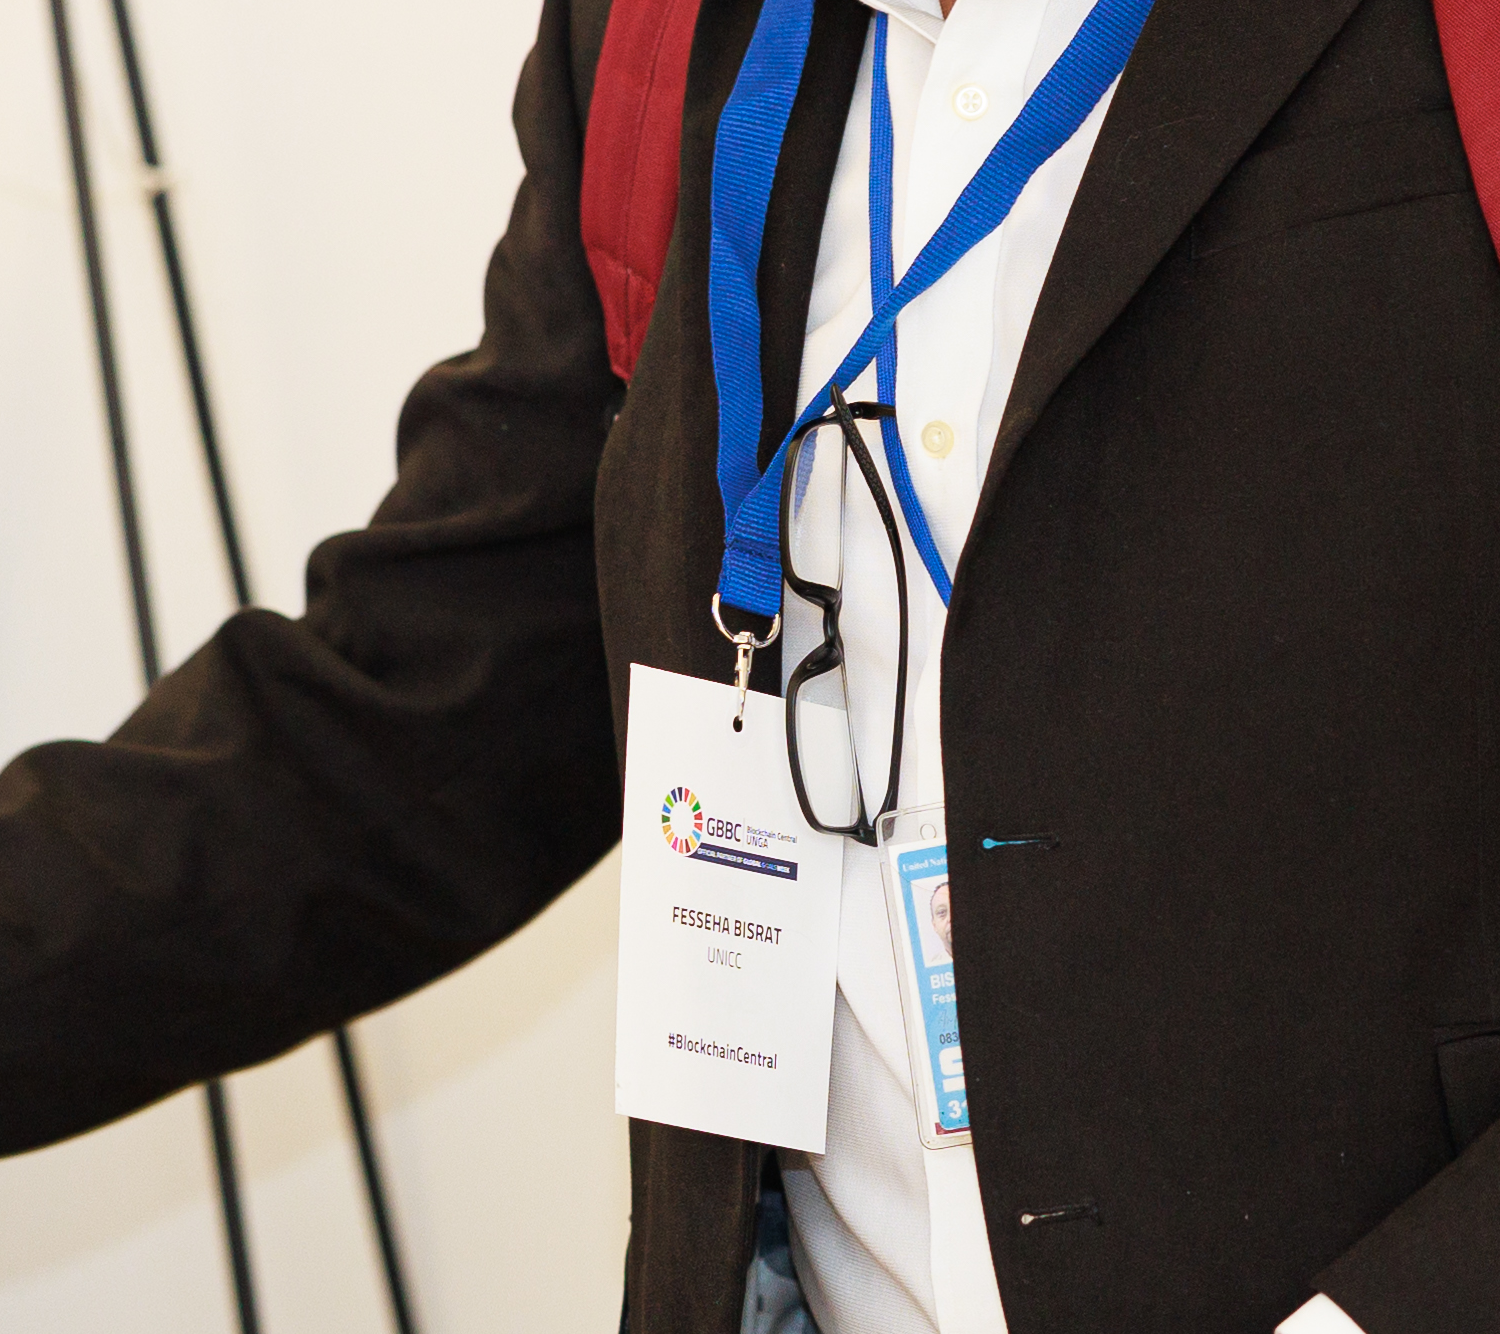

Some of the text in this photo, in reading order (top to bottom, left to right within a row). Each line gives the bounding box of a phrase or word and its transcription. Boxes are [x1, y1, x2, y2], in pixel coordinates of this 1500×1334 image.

[706, 817, 742, 843] GBBC
[746, 834, 769, 849] UNGA
[777, 832, 797, 844] Central
[672, 906, 783, 945] FESSEHA BISRAT
[707, 946, 742, 970] UNICC
[668, 1032, 777, 1070] #BlockchainCentral
